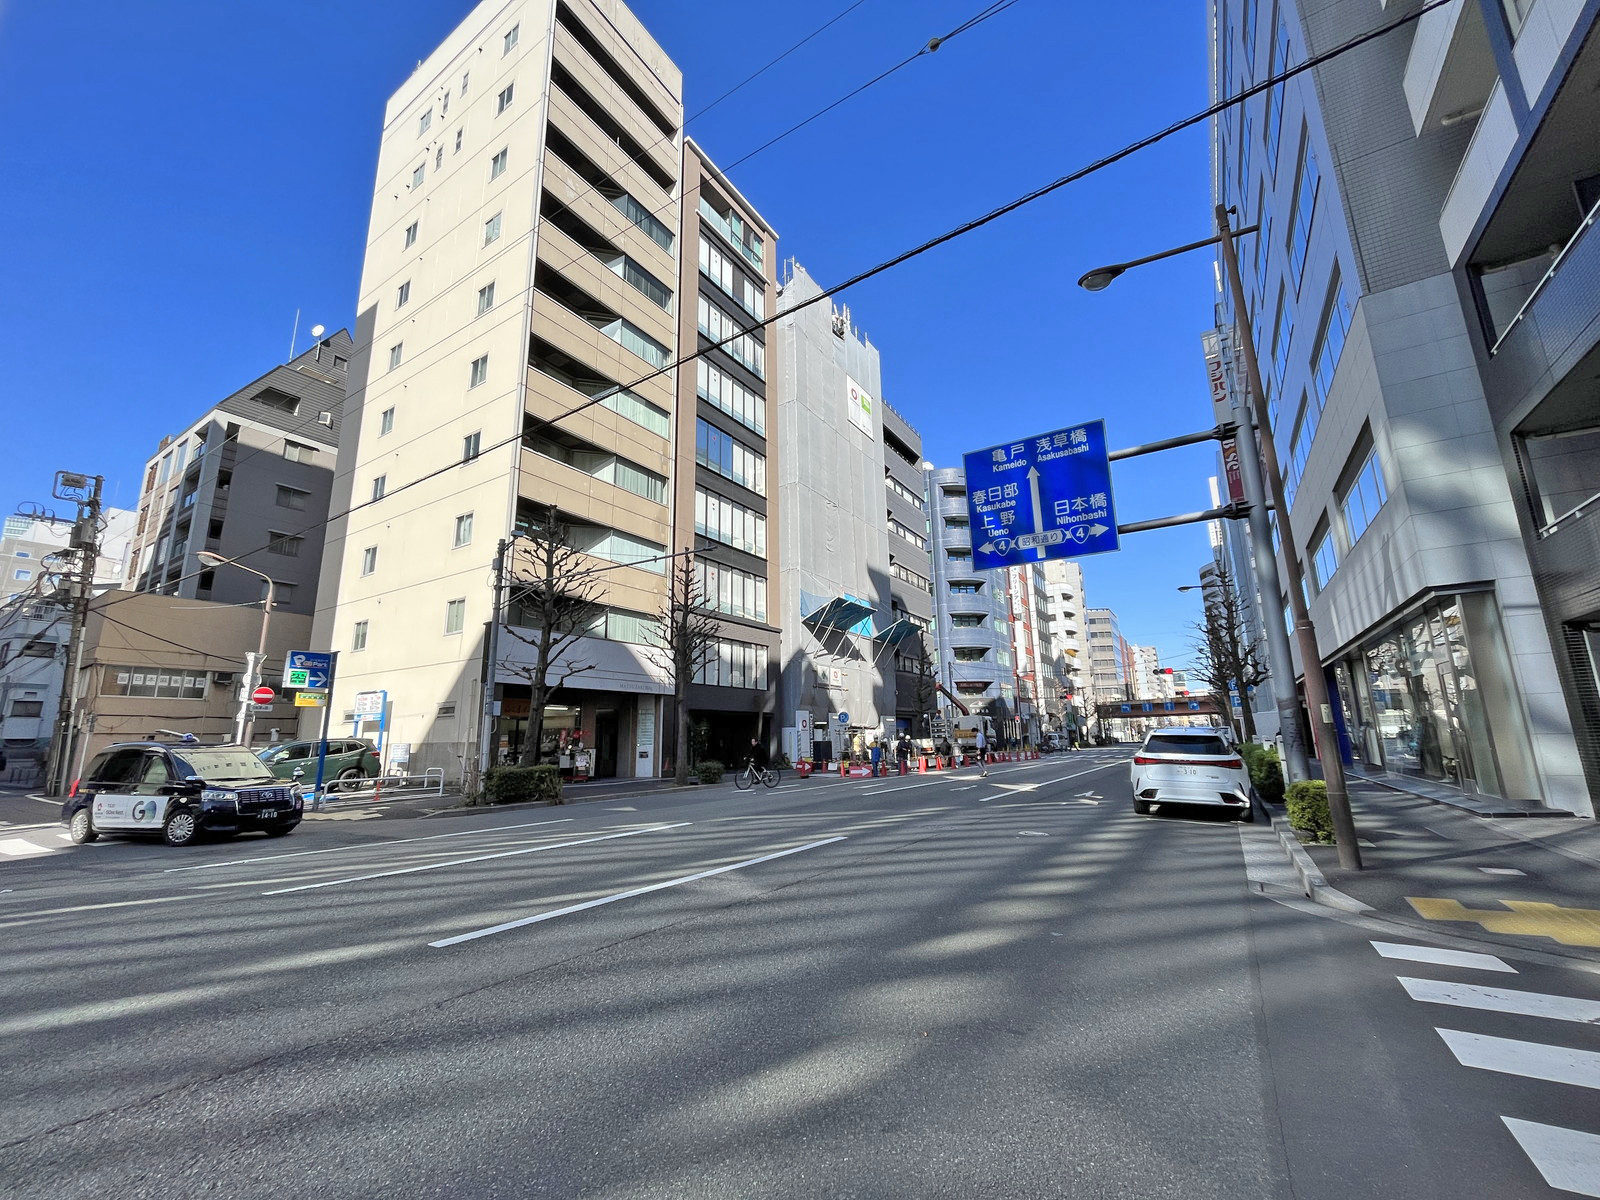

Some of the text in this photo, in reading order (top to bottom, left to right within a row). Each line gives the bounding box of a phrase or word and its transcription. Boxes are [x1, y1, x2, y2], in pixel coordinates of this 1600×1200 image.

[1036, 428, 1087, 453] 浅草橋
[992, 443, 1025, 463] 亀戸
[1037, 443, 1089, 462] Asakusabashi
[993, 459, 1027, 472] Kameido
[972, 483, 1018, 505] 春日部
[976, 500, 1017, 513] Kasukabe
[1055, 493, 1107, 516] 日本橋
[980, 510, 1015, 530] 上野
[1056, 509, 1107, 525] Nihonbashi
[988, 528, 1009, 538] Ueno
[1021, 532, 1058, 546] 昭和通り
[1076, 527, 1084, 538] 4
[1000, 541, 1007, 550] 4
[290, 671, 307, 685] 空
